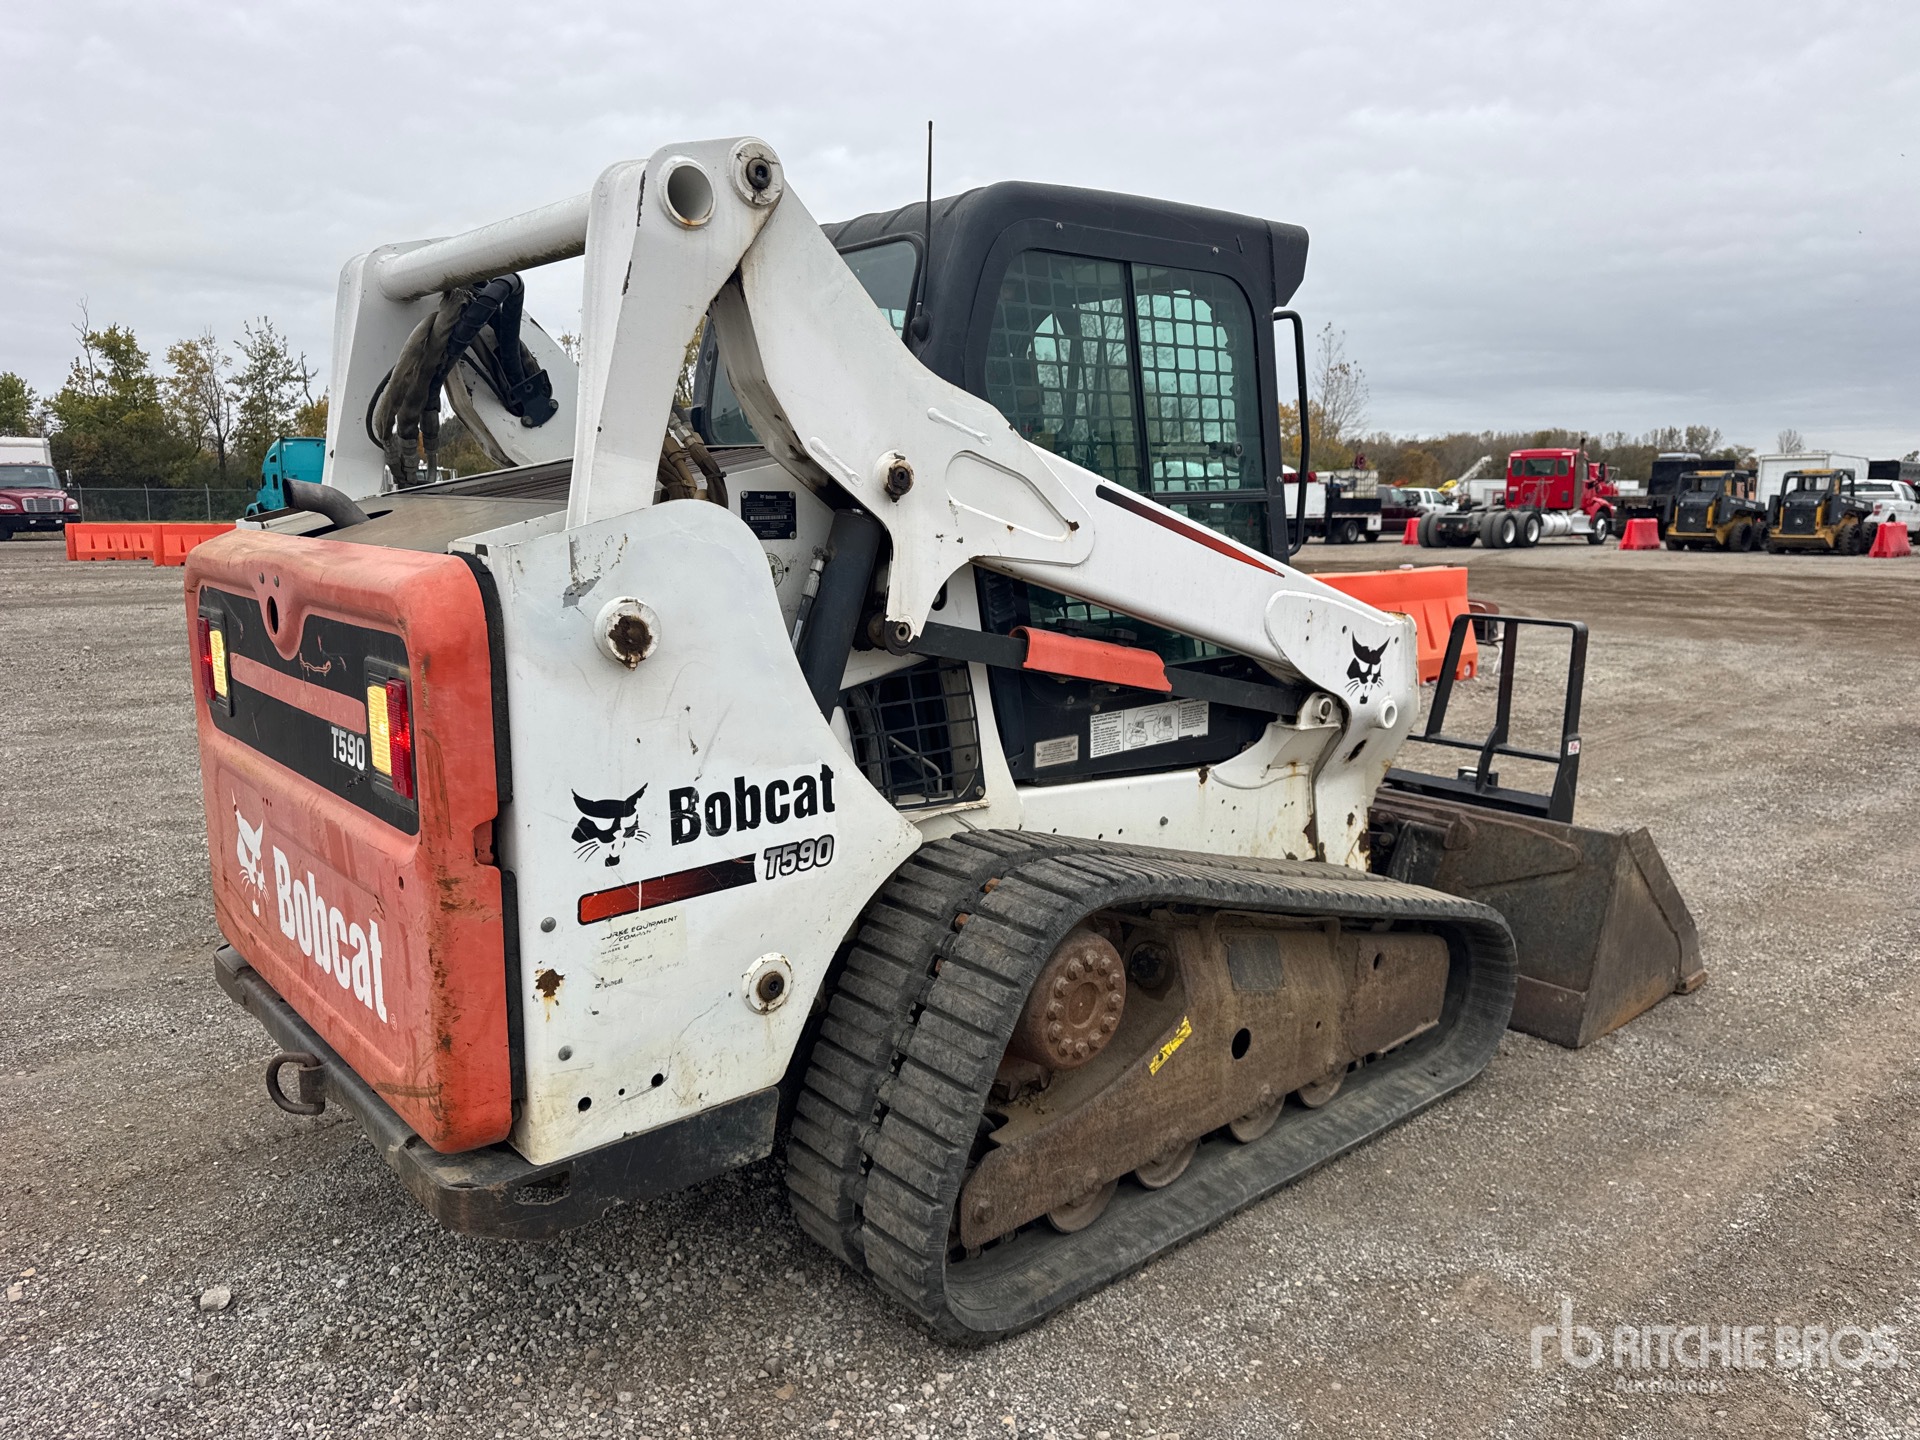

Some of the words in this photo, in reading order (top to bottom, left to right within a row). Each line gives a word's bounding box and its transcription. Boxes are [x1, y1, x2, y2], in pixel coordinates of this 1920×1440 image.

[331, 726, 366, 771] T590
[669, 764, 836, 846] Bobcat
[763, 834, 835, 880] T590
[272, 845, 388, 1024] Bobcat
[601, 928, 629, 941] URKE
